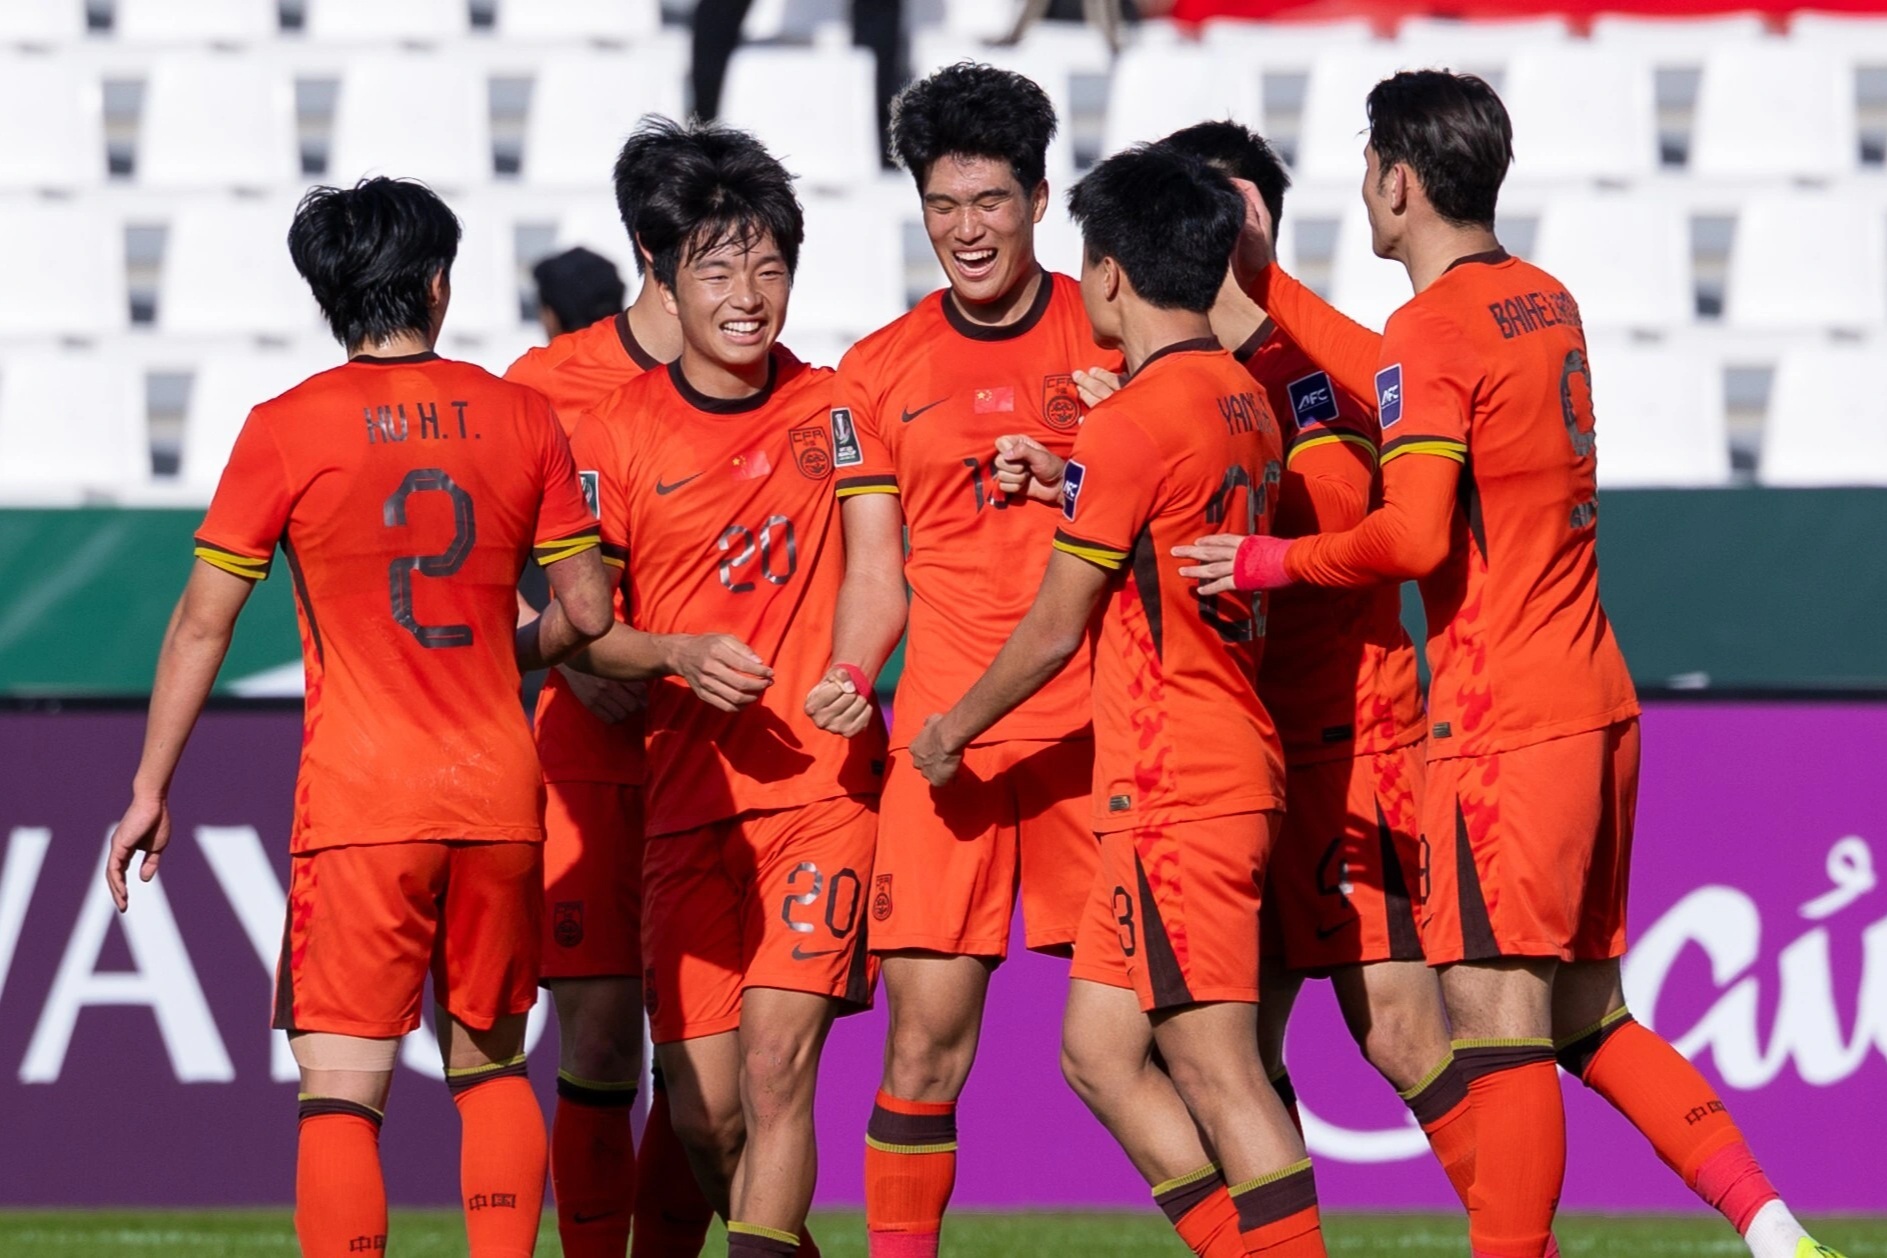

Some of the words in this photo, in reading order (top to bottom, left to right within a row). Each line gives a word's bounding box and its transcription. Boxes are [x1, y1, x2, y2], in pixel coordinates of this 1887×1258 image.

[1298, 388, 1328, 410] AFC
[1381, 385, 1398, 405] AFC
[363, 404, 409, 444] HU
[417, 401, 481, 440] H.T.
[383, 468, 476, 648] 2
[717, 515, 797, 593] 20
[781, 862, 861, 939] 20
[468, 1193, 516, 1211] 中国
